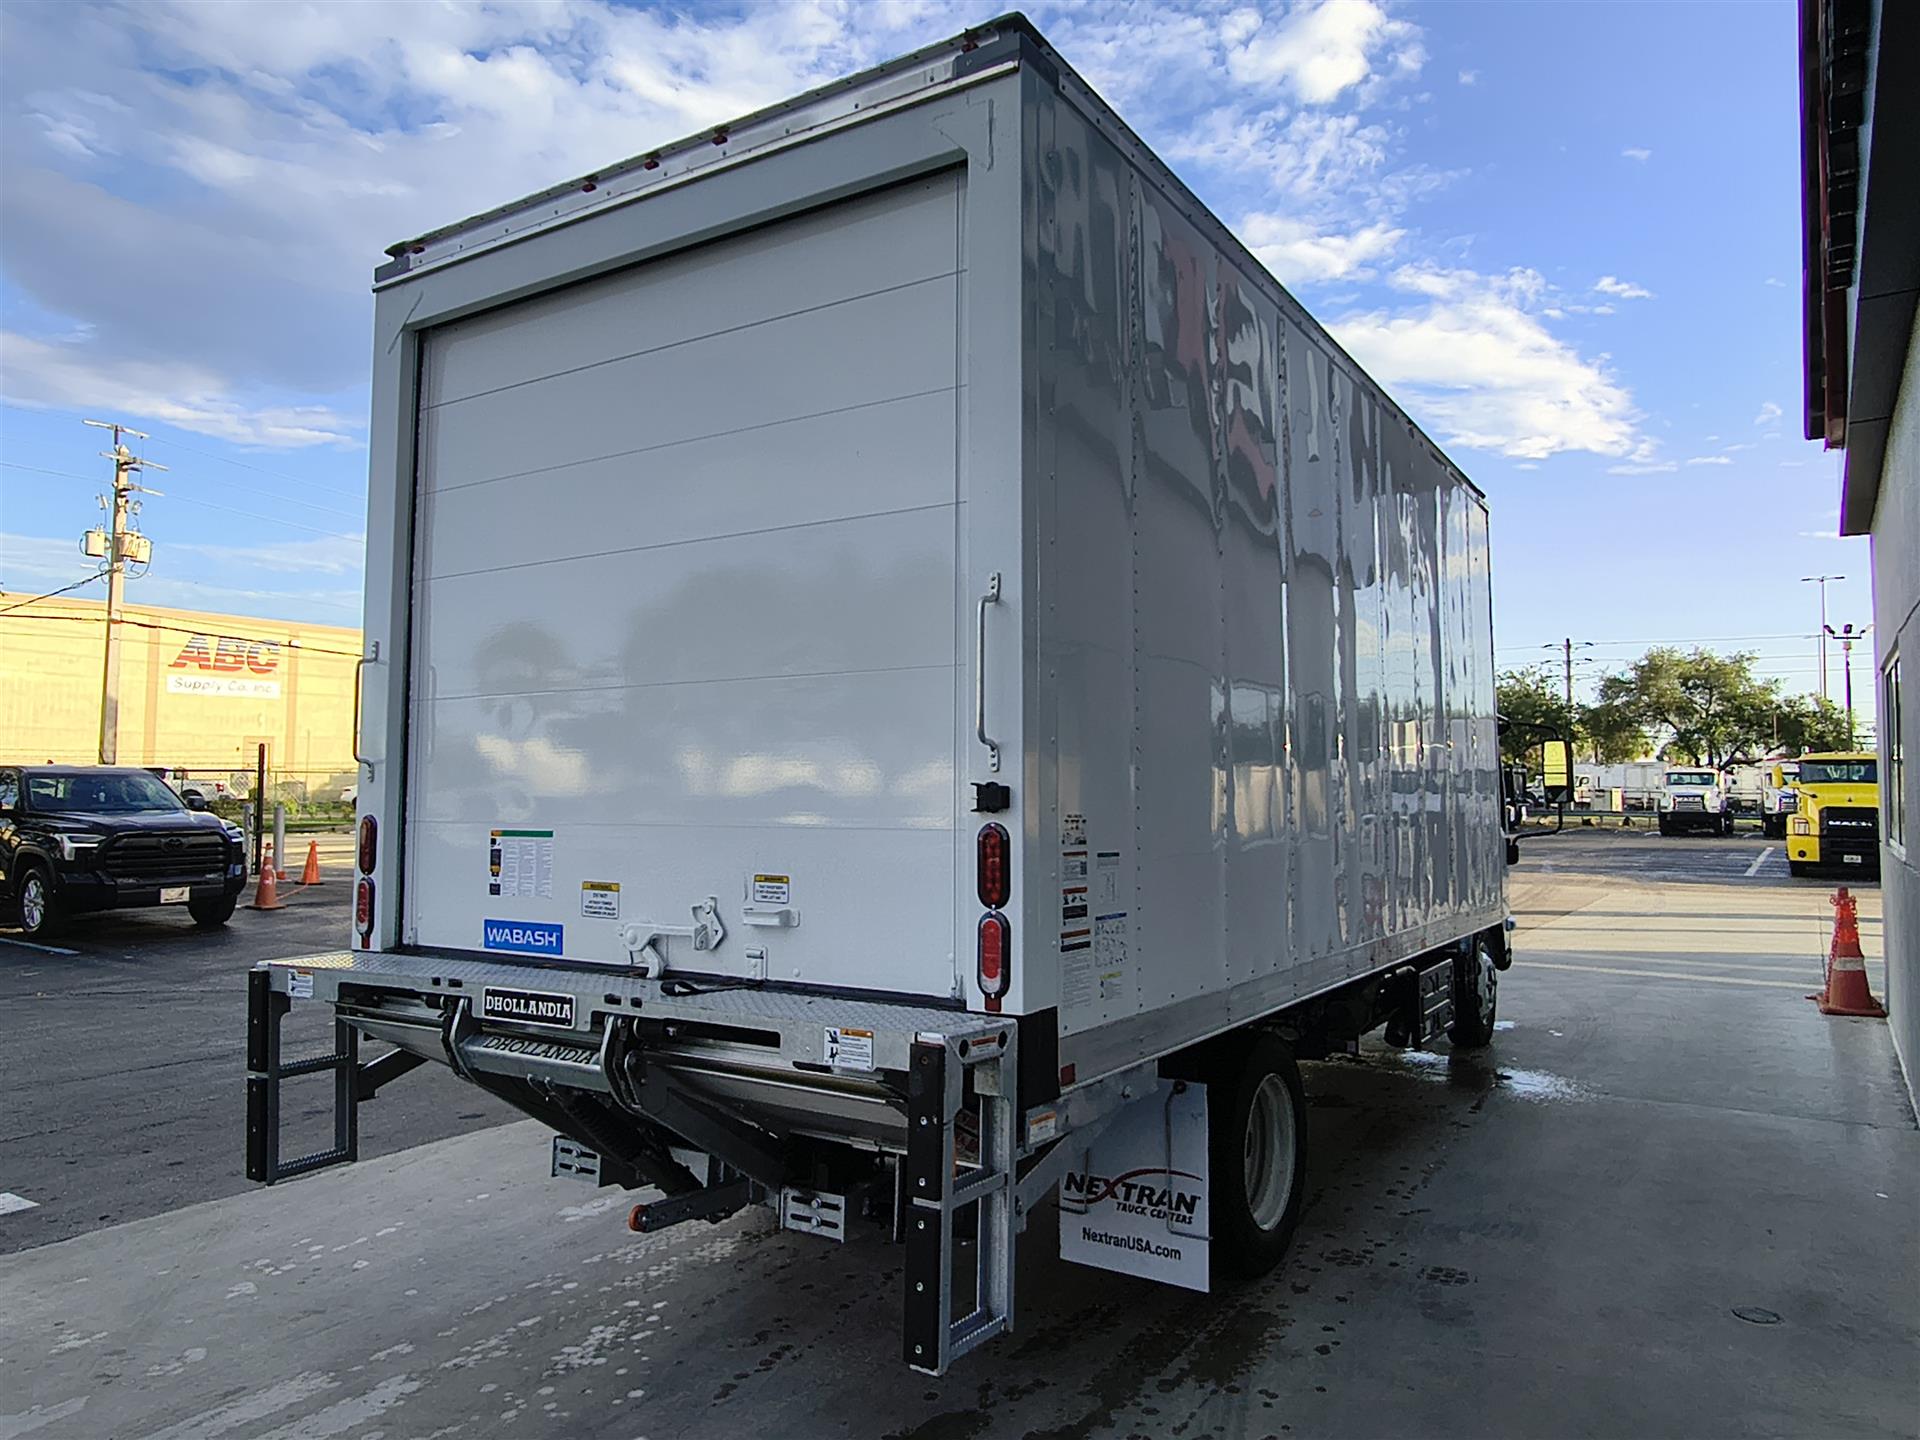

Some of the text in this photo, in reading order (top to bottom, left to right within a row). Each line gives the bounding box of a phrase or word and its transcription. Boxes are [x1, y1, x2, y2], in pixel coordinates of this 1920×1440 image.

[168, 634, 281, 675] ABC
[174, 676, 221, 693] Supply
[487, 926, 557, 948] WABASH
[485, 995, 571, 1020] DHOLLANDIA
[483, 1036, 595, 1064] DHOLLANDIA
[1064, 1170, 1199, 1214] NEXTRAN
[1116, 1201, 1194, 1226] TRUCK CENTERS
[1082, 1226, 1182, 1261] NextranUSA.com
